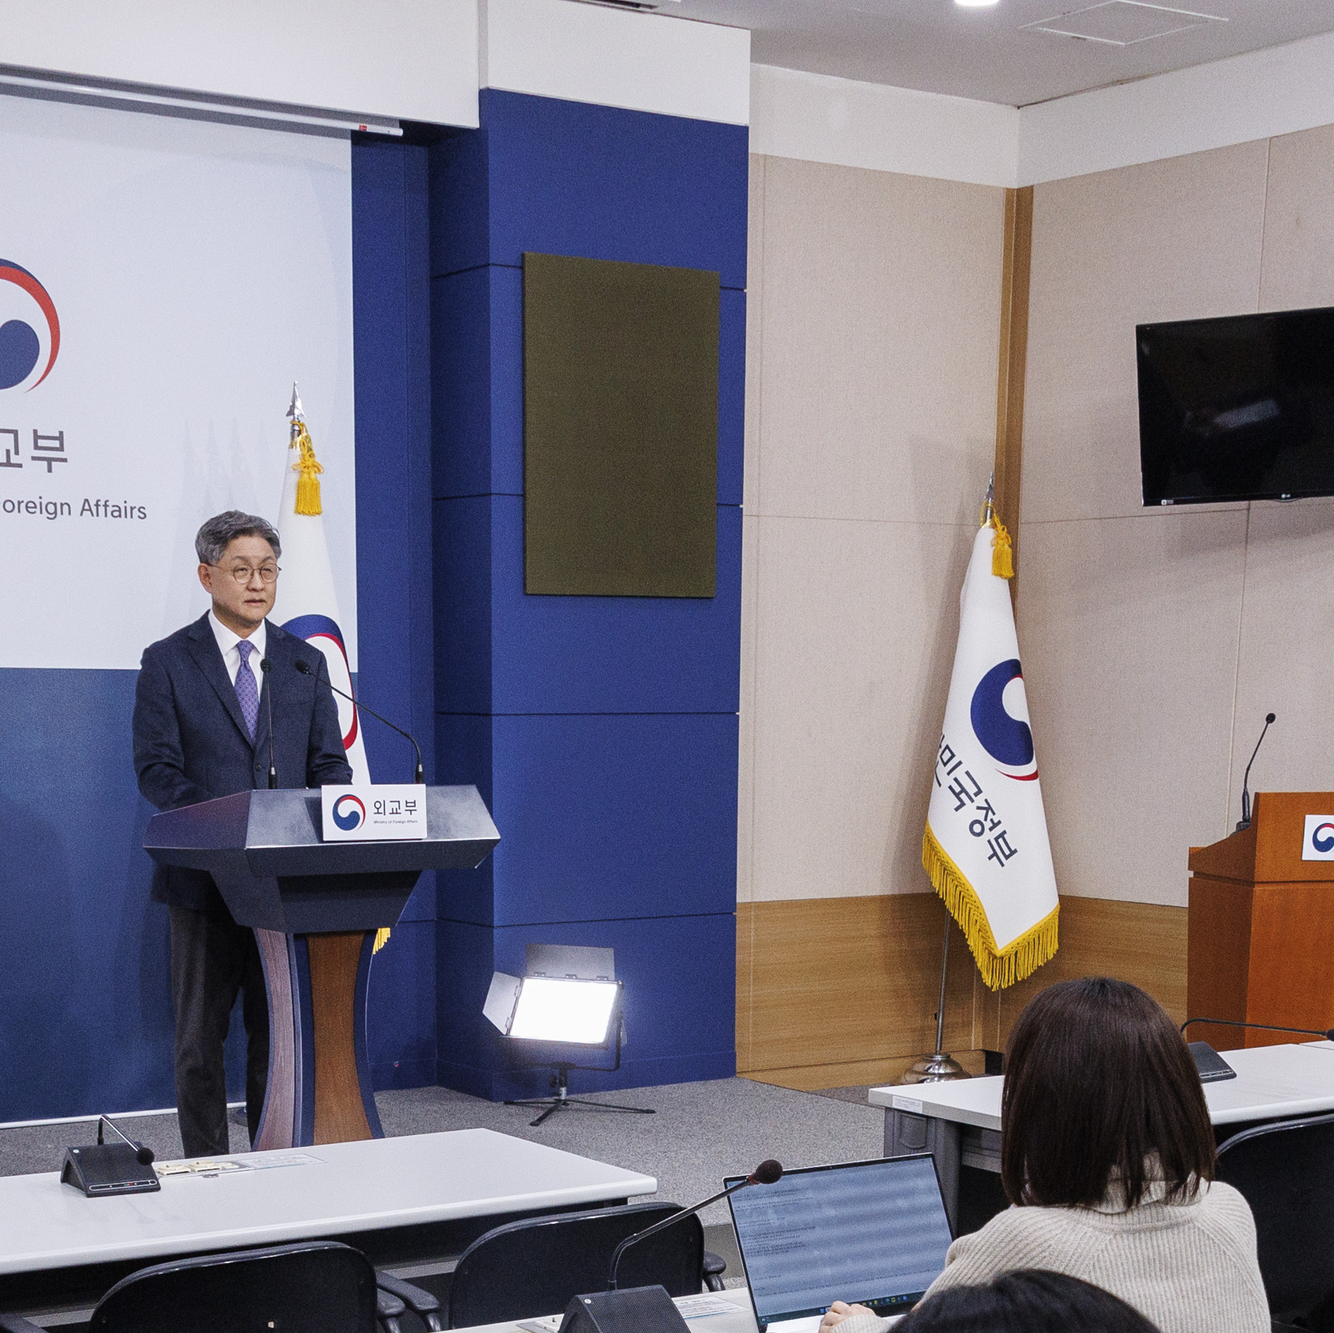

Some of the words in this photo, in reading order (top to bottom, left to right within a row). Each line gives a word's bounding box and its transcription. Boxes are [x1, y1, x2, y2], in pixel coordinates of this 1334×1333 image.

[80, 498, 147, 520] Affairs
[373, 799, 417, 816] 외교부
[935, 734, 1018, 868] 민국정부
